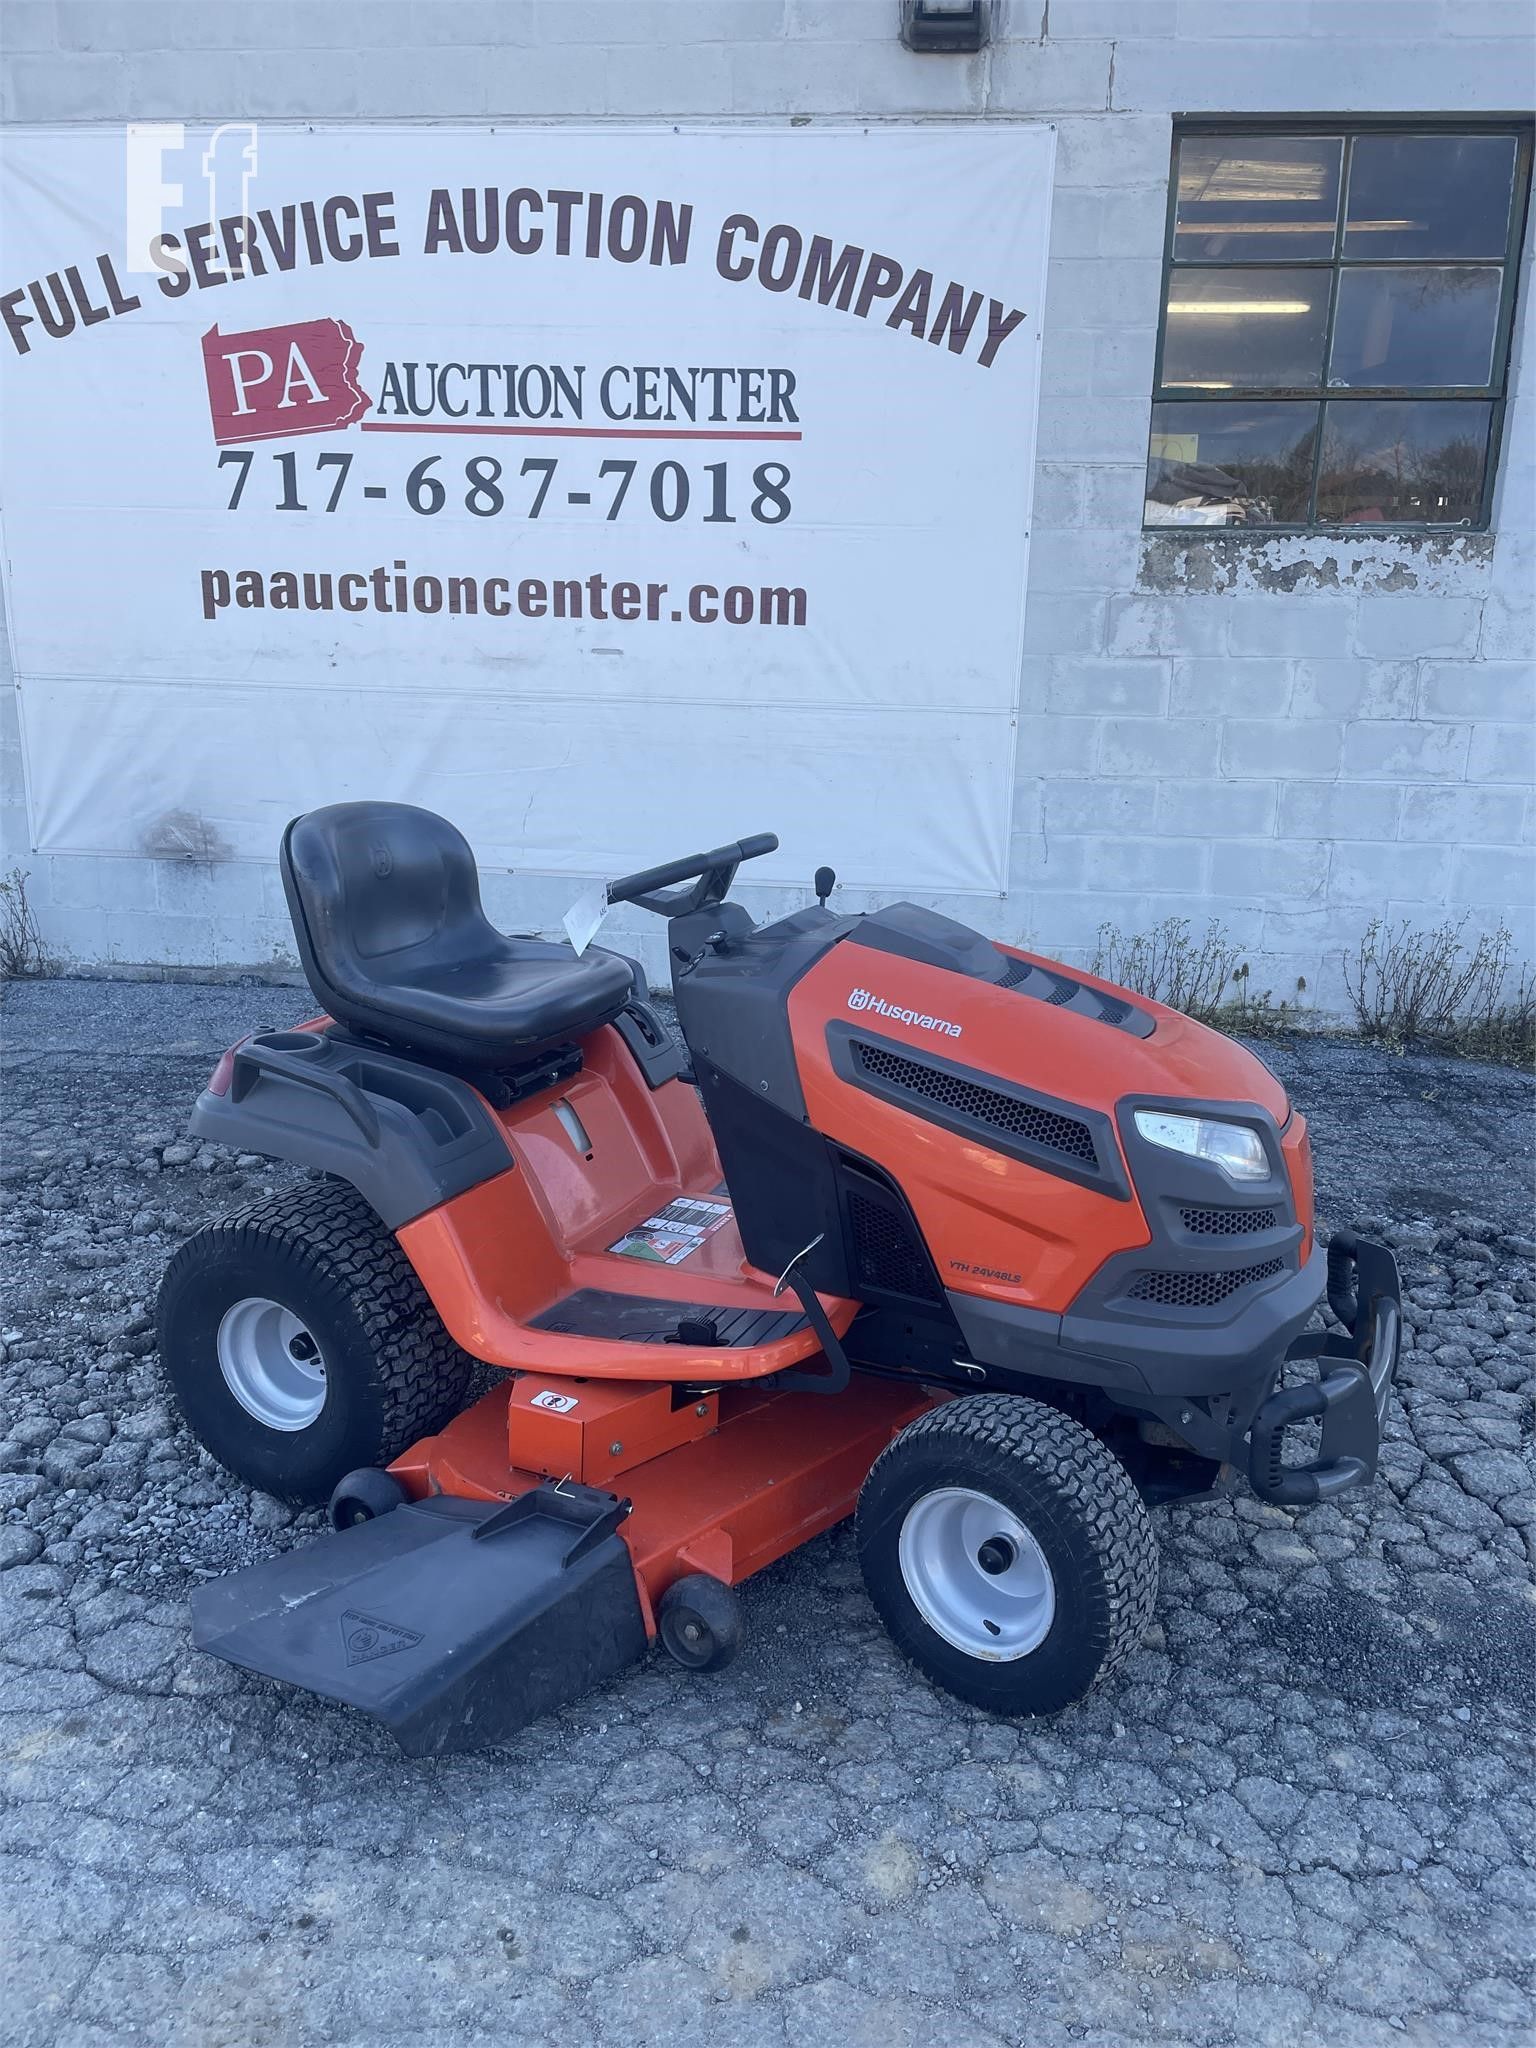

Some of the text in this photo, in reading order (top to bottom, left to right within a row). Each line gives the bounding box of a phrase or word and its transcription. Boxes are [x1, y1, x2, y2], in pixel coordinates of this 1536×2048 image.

[0, 187, 1028, 369] FULL SERVICE AUCTION COMPANY
[221, 341, 330, 416] PA
[376, 362, 800, 423] AUCTION CENTER
[201, 560, 808, 626] paauctioncenter.com
[866, 995, 963, 1038] Husqvarna
[949, 1260, 970, 1272] YTH
